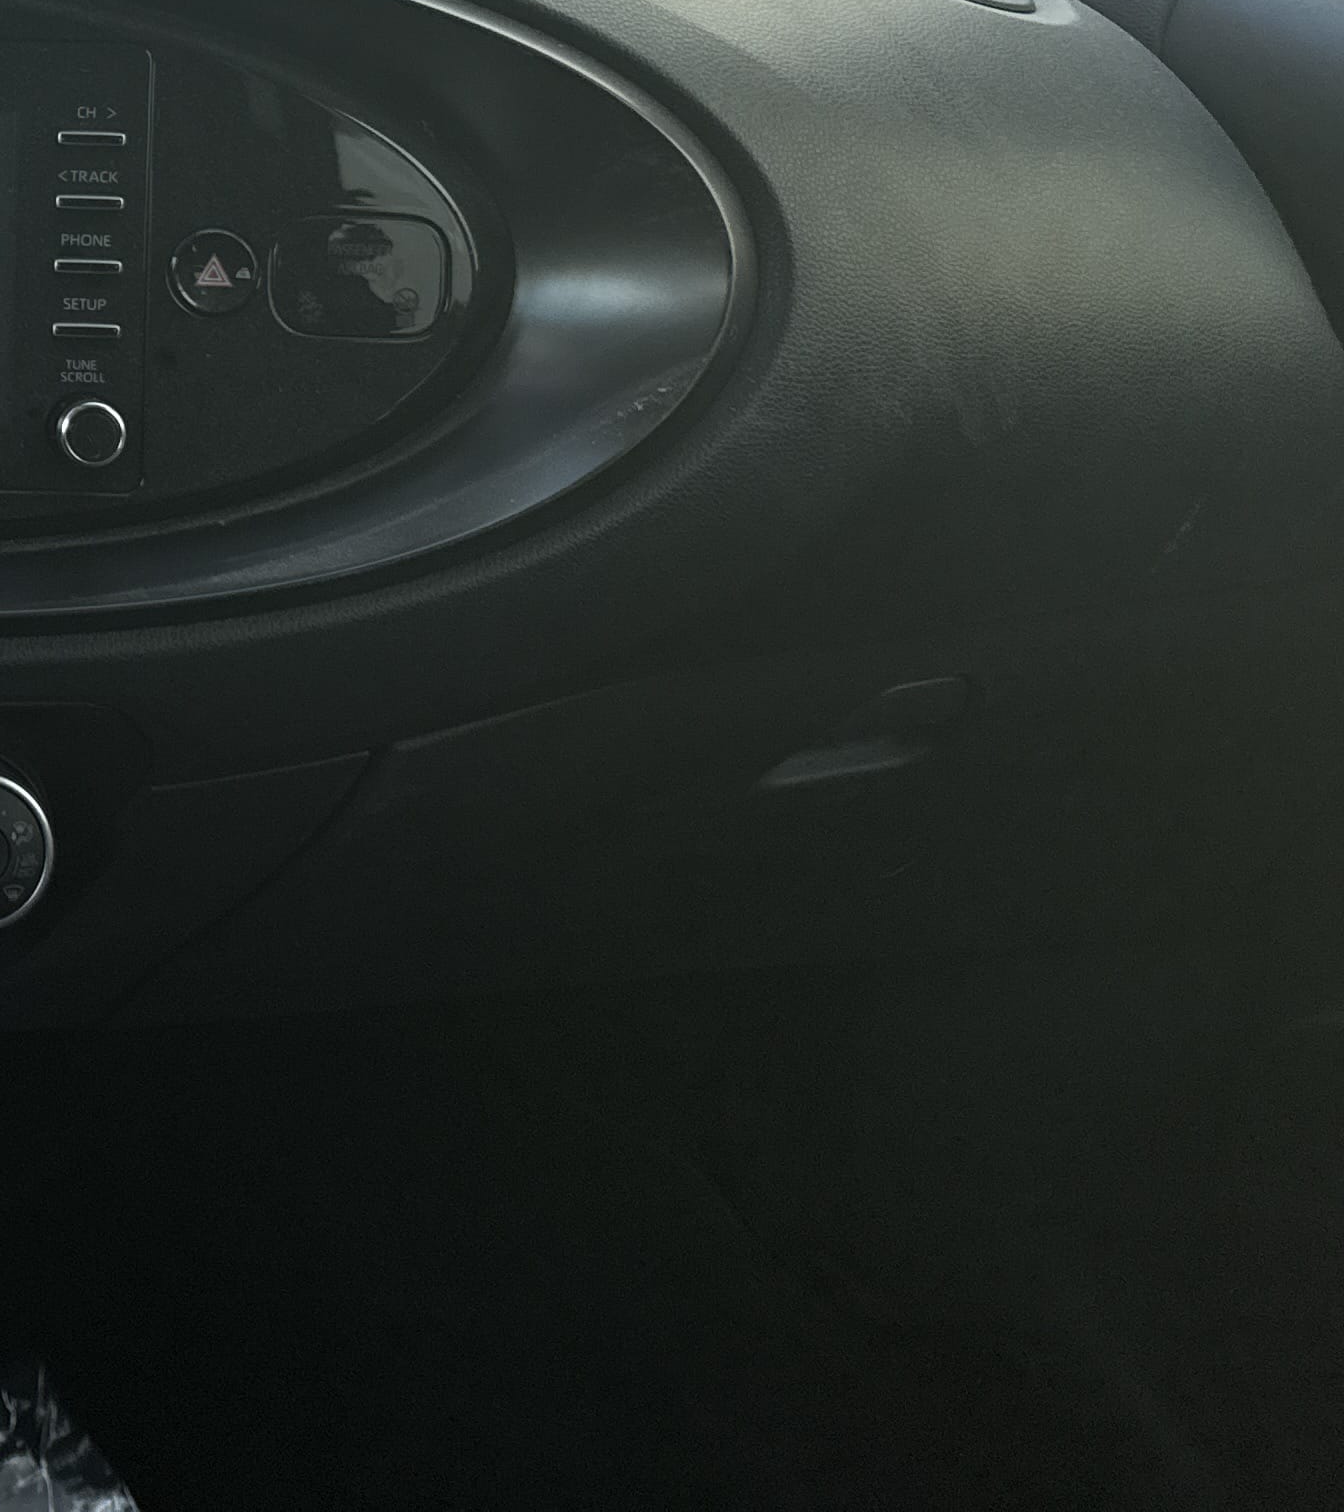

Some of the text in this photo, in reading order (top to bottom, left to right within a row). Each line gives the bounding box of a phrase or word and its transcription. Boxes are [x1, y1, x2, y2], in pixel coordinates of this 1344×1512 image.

[60, 233, 113, 248] PHONE
[63, 297, 108, 311] SETUP
[65, 359, 98, 371] TUNE
[59, 371, 107, 384] SCROLL
